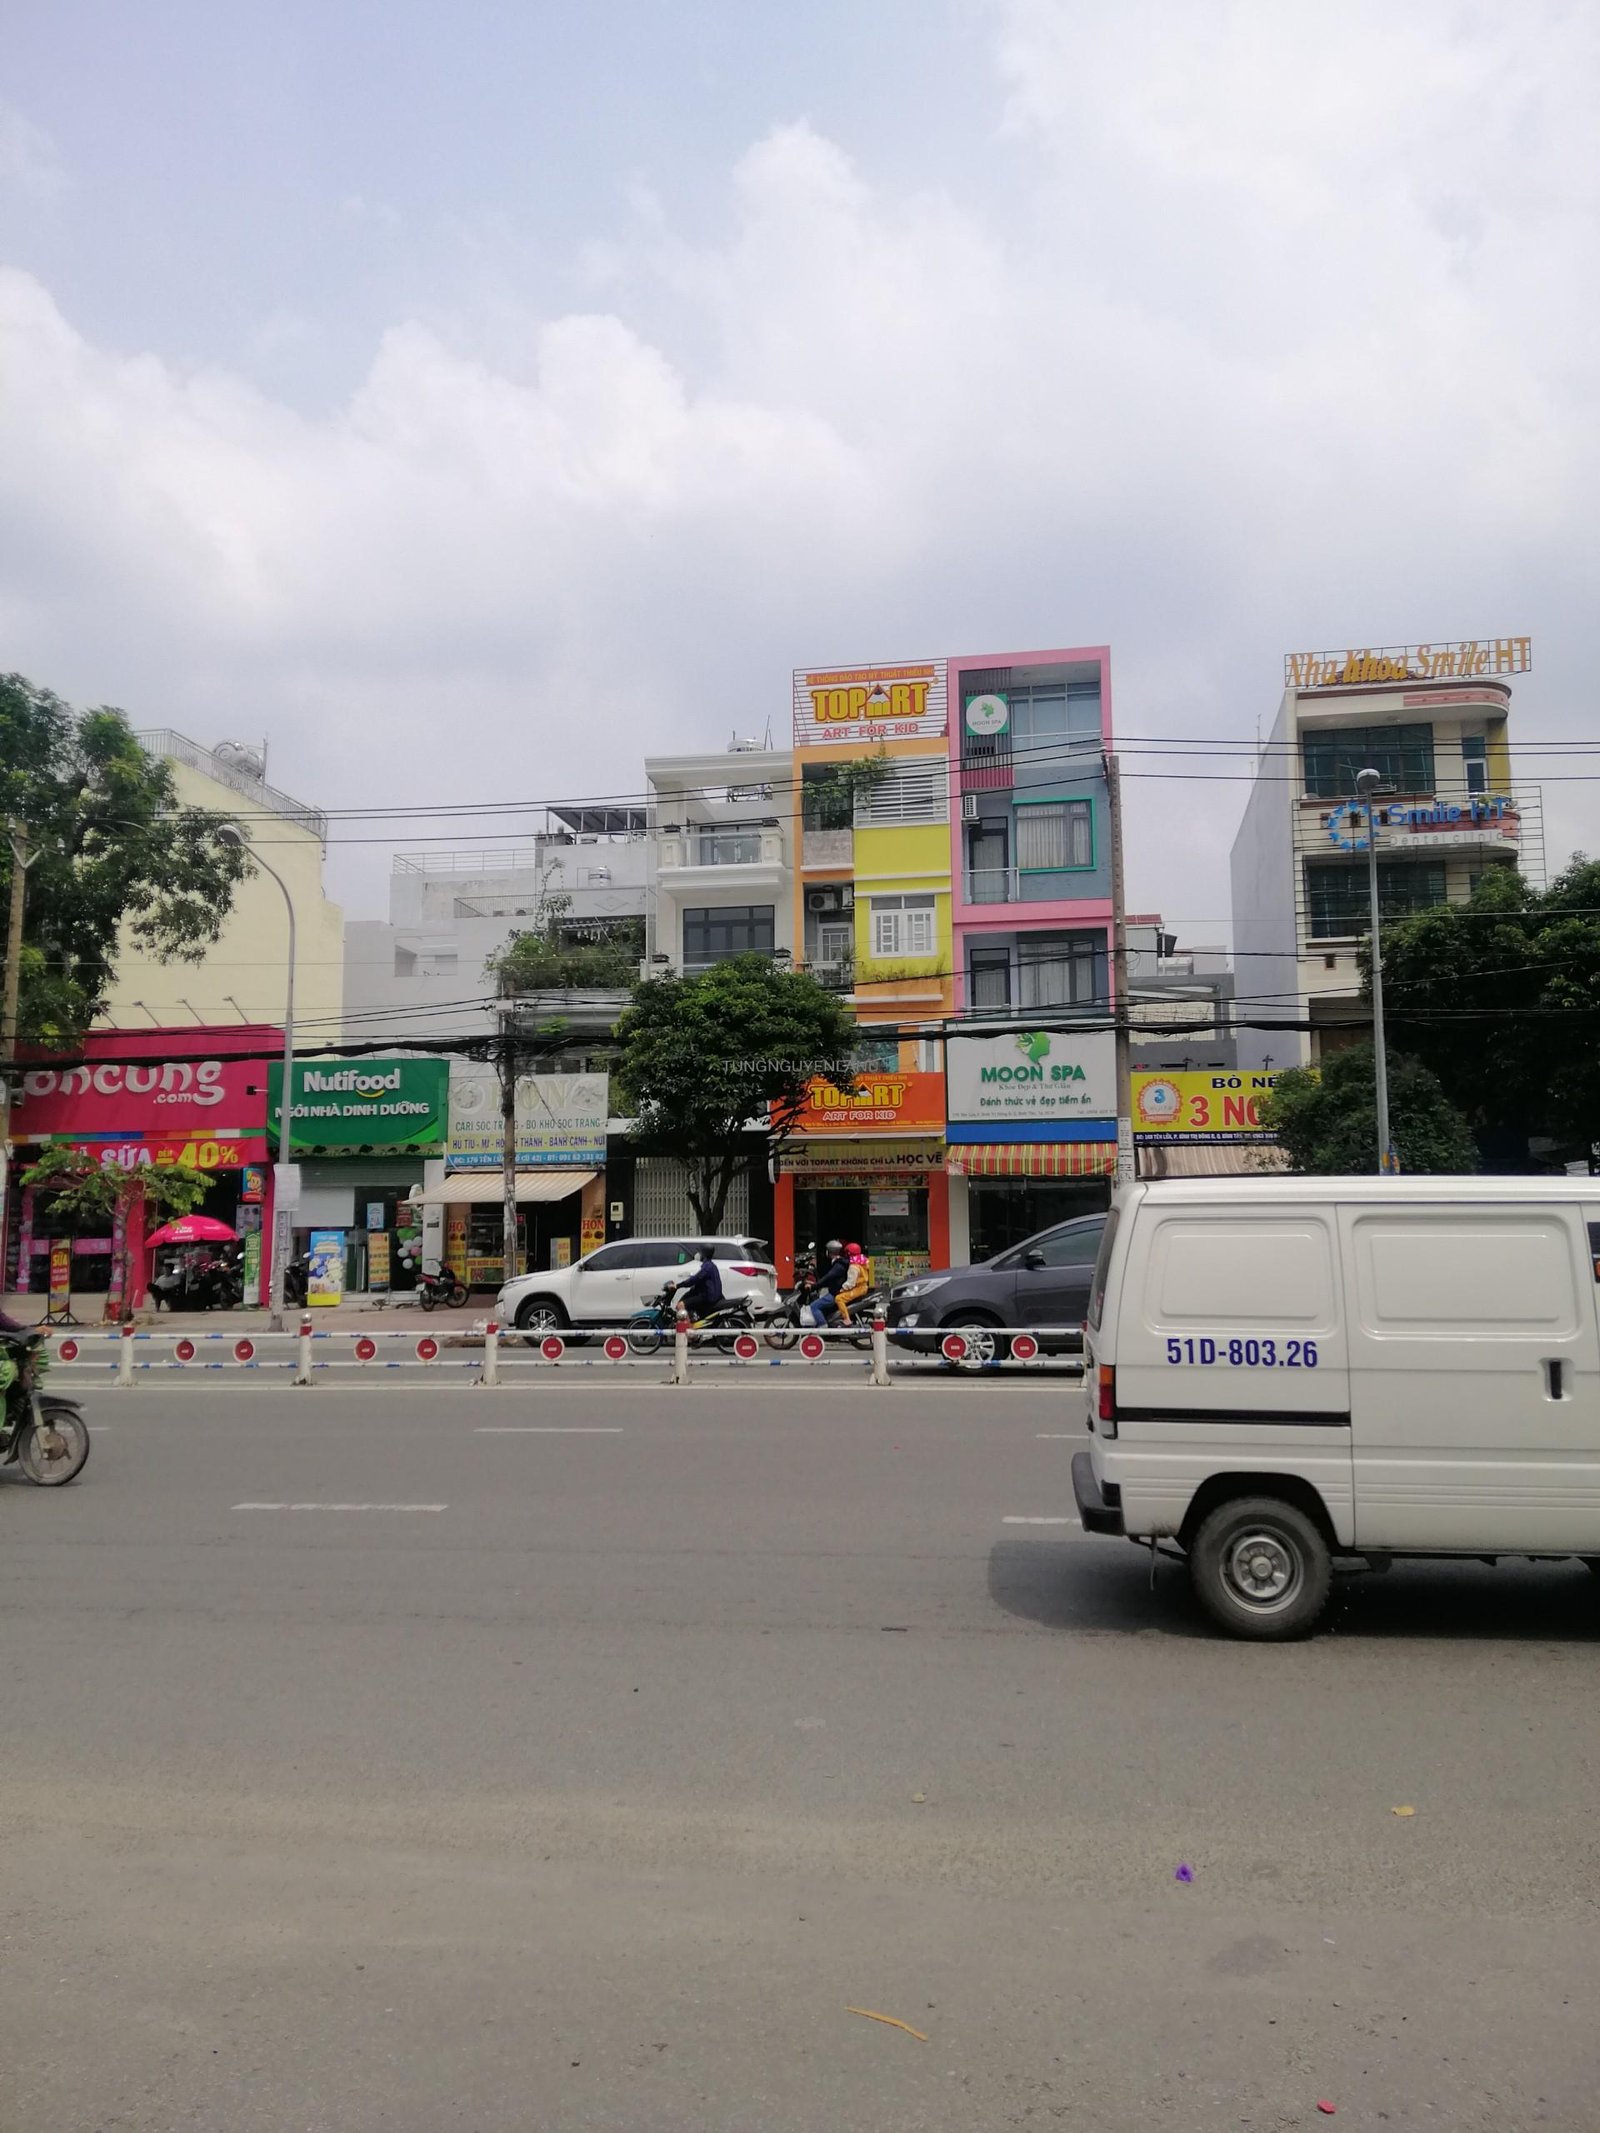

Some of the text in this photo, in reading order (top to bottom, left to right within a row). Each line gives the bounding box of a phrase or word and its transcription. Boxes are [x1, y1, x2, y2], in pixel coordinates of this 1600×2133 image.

[1289, 637, 1531, 687] Nha Khoa Smile HT
[822, 722, 919, 739] ART FOR KID
[1387, 797, 1506, 826] Smile HT
[1389, 831, 1448, 846] Dental
[303, 1068, 400, 1093] Nutifood
[981, 1065, 1086, 1082] MOON SPA
[1212, 1074, 1241, 1088] BÒ
[153, 1092, 193, 1104] .com
[980, 1096, 1001, 1106] Đánh
[1005, 1095, 1023, 1105] thức
[1040, 1096, 1056, 1107] đẹp
[1154, 1088, 1166, 1104] 3
[311, 1103, 340, 1116] NHÀ
[343, 1105, 377, 1116] DINH
[380, 1102, 429, 1115] DƯỠNG
[824, 1110, 896, 1121] ART FOR KID
[1189, 1095, 1210, 1127] 3
[102, 1144, 151, 1172] SỮA
[177, 1142, 238, 1169] 40%
[795, 1157, 809, 1166] VỚI
[810, 1157, 840, 1166] TOPART
[841, 1156, 868, 1165] KHÔNG
[897, 1154, 925, 1168] HỌC
[927, 1151, 943, 1164] VẼ
[1167, 1338, 1318, 1368] 51D-803.26
